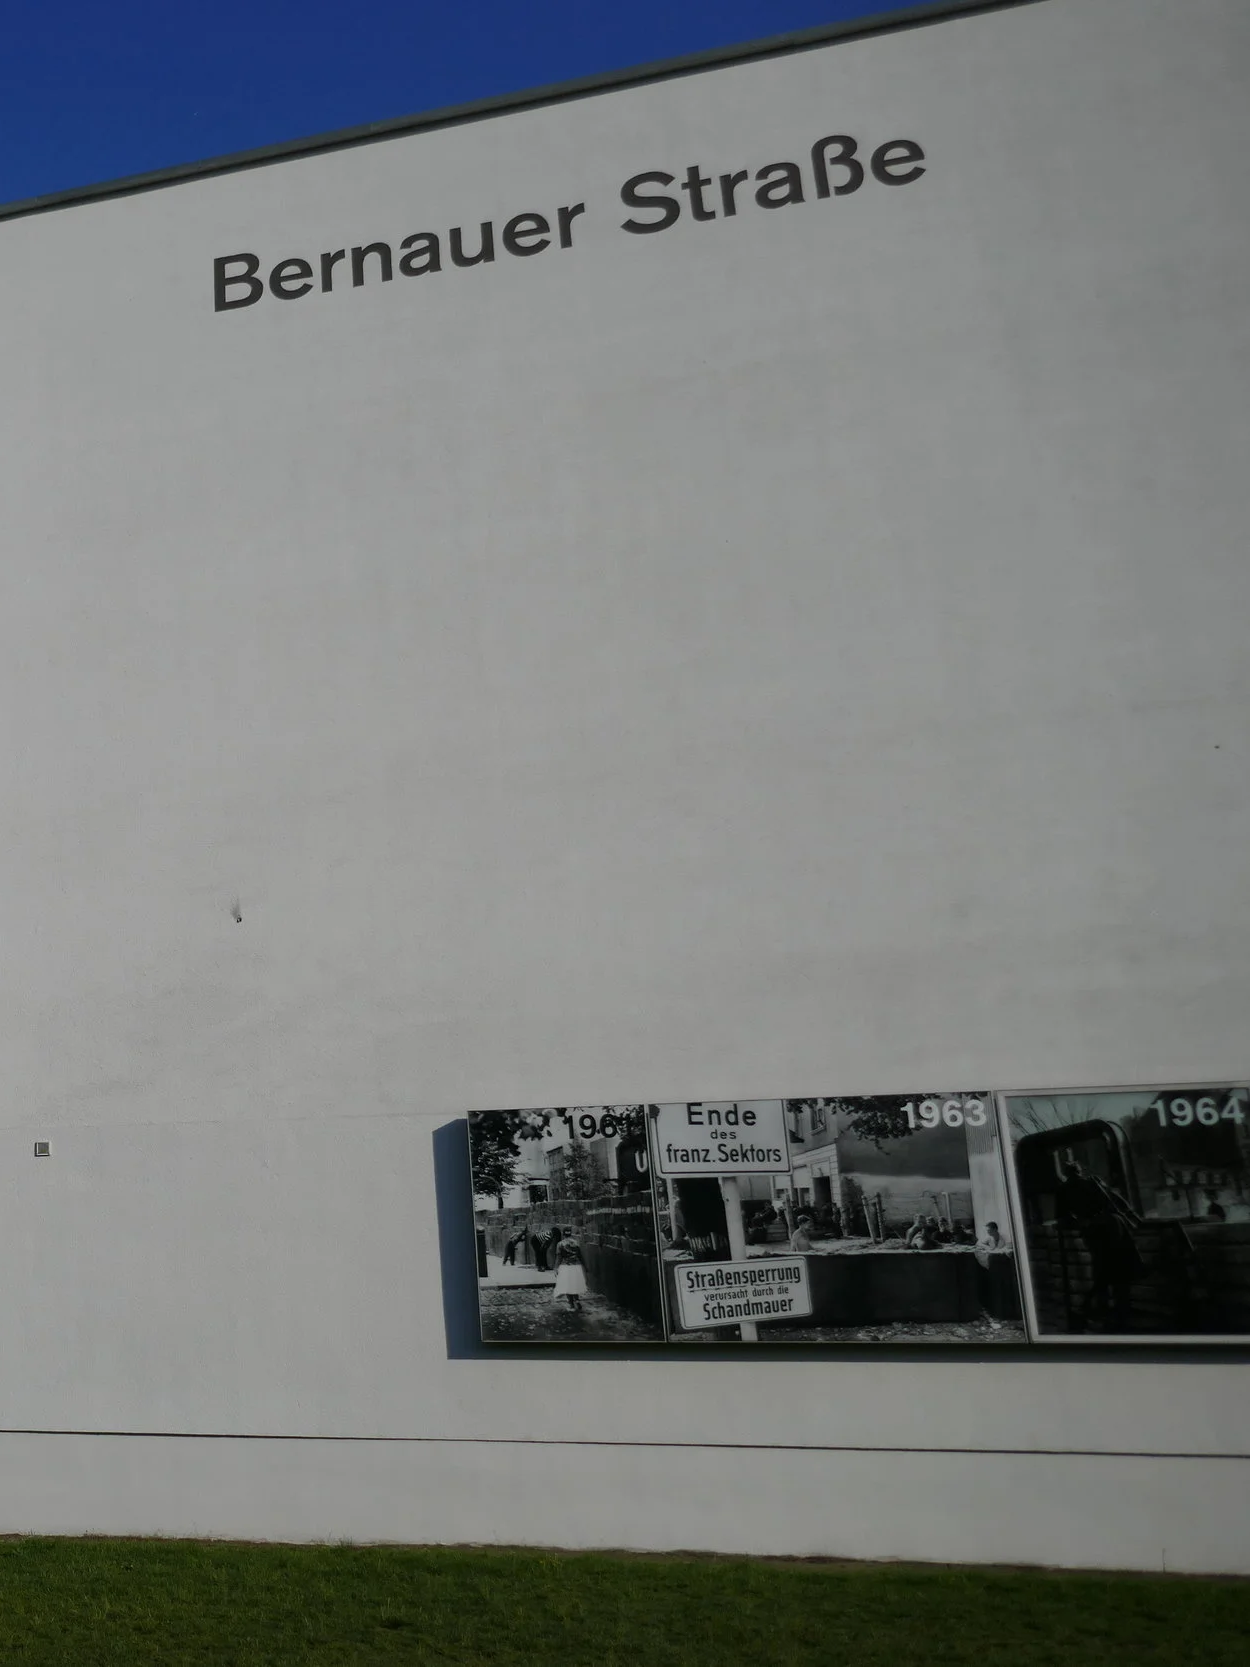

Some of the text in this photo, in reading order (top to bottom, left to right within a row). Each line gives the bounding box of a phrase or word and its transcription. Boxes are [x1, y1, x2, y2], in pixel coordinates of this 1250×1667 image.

[212, 135, 926, 313] Bernauer Straße
[686, 1102, 757, 1126] Ende
[900, 1099, 987, 1129] 1963
[1150, 1096, 1245, 1127] 1964
[710, 1129, 737, 1140] des
[717, 1143, 782, 1163] Sektors
[686, 1266, 801, 1289] Straßensperrung
[704, 1286, 789, 1301] verursacht durch die
[703, 1298, 794, 1320] Schandmauer
